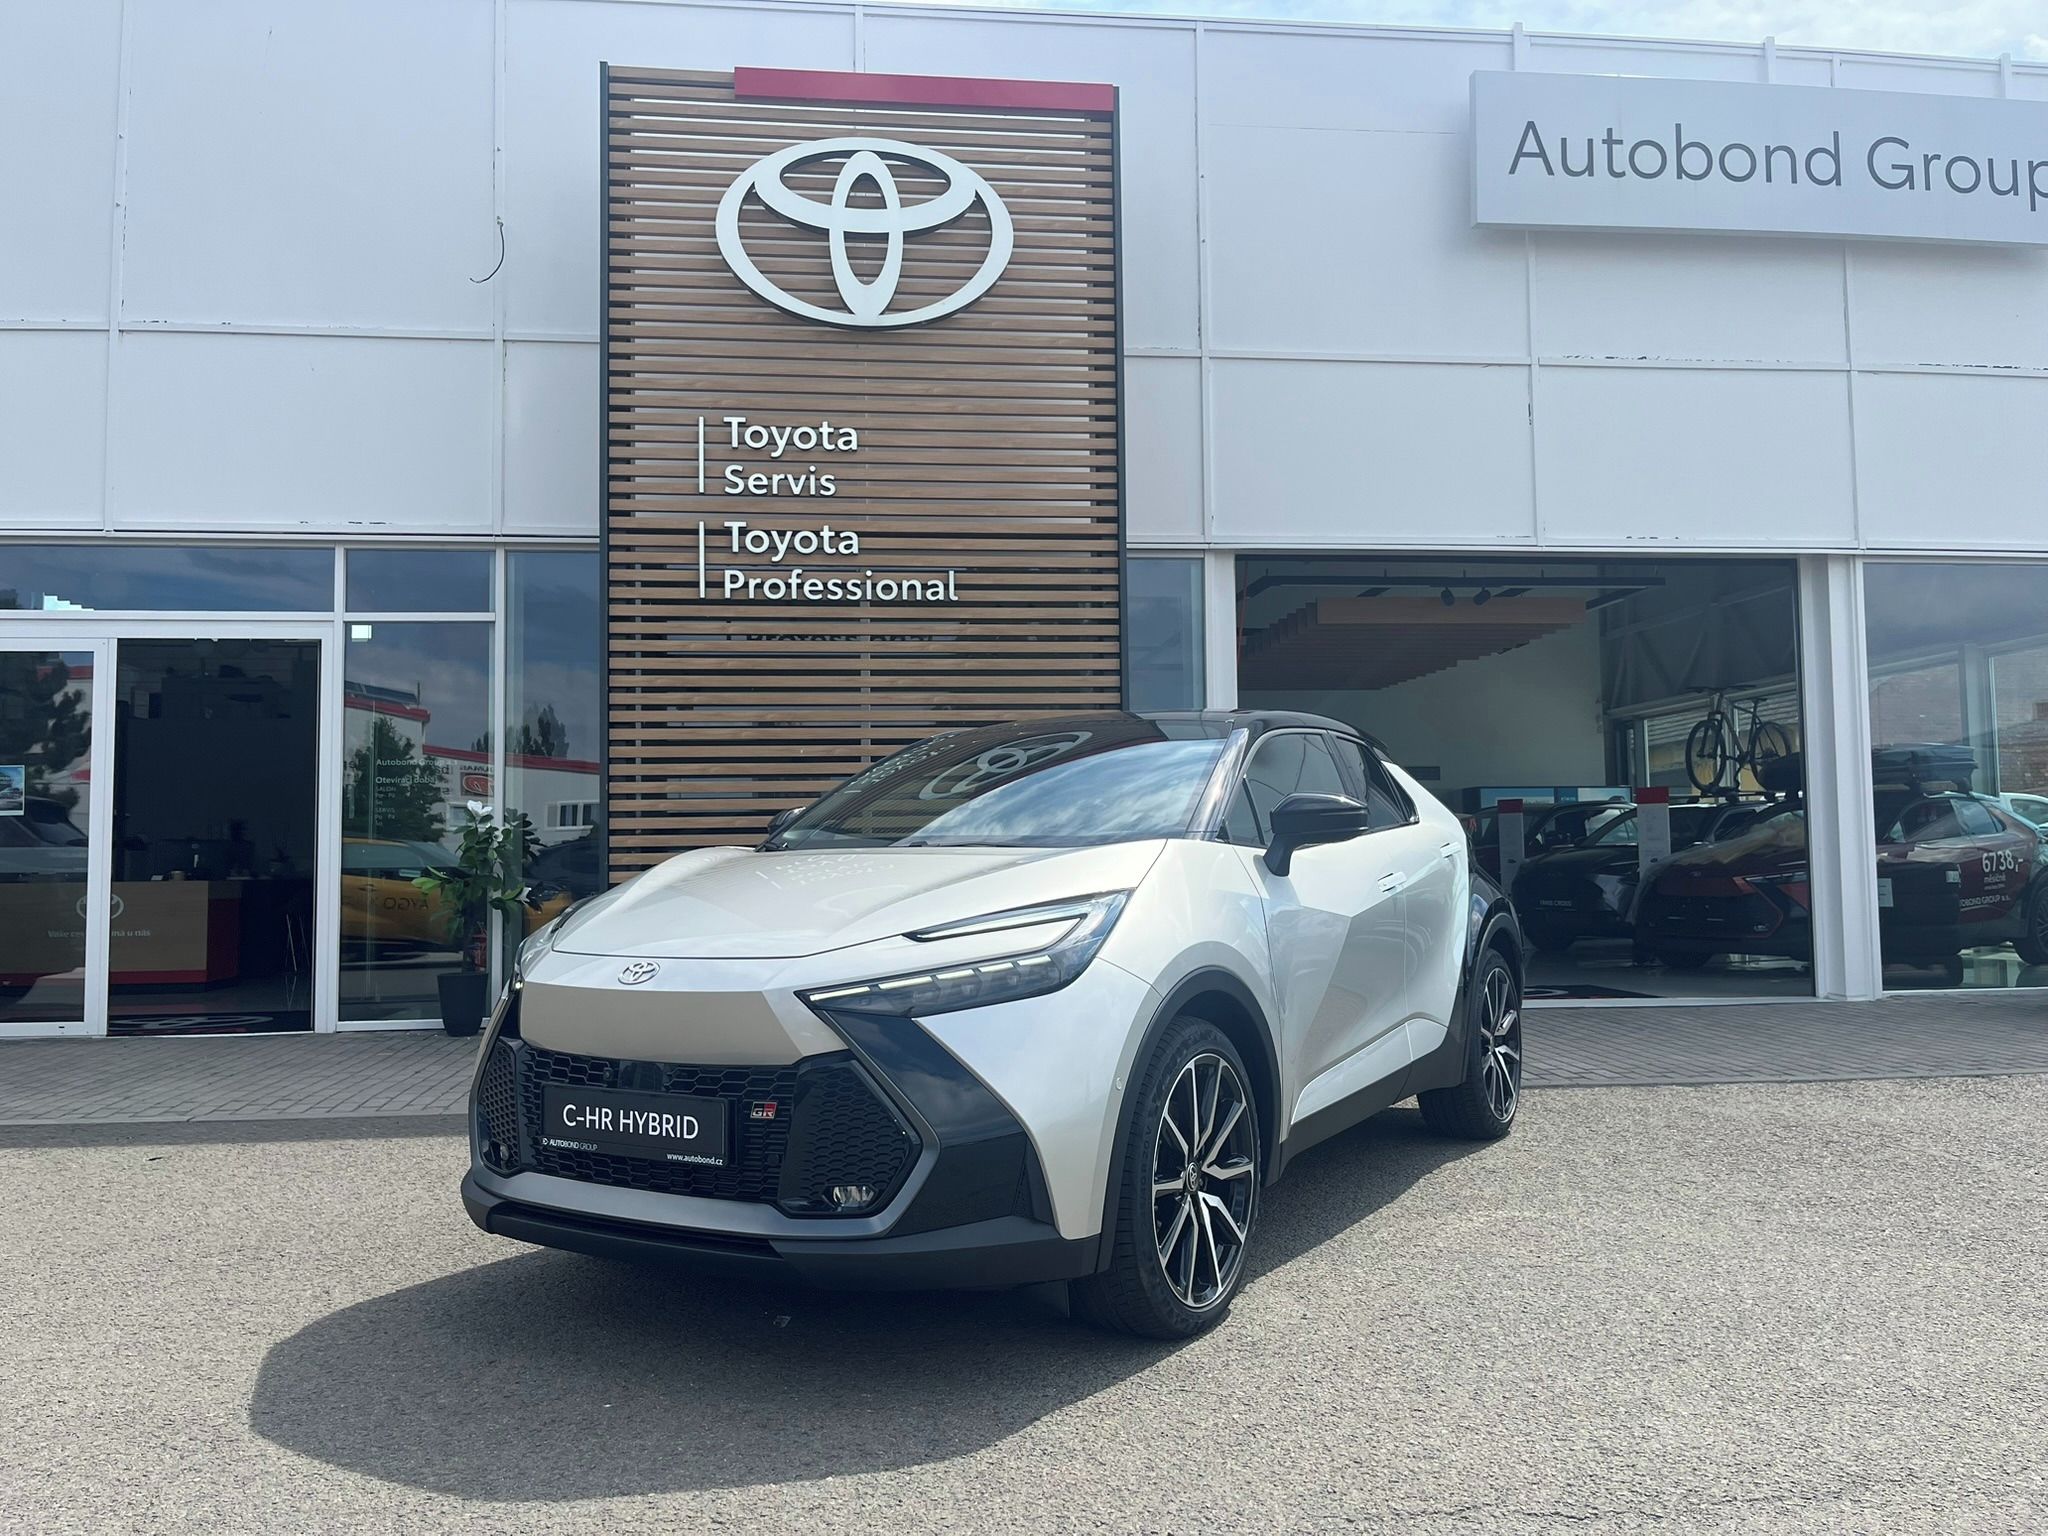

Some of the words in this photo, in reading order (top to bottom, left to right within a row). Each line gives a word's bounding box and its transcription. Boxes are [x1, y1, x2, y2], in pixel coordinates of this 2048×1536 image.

[1508, 120, 1843, 187] Autobond
[1866, 136, 2048, 212] Group
[723, 416, 859, 458] Toyota
[724, 465, 837, 496] Servis
[724, 521, 860, 563] Toyota
[724, 569, 959, 601] Professional
[376, 759, 417, 767] Autobond
[562, 1103, 613, 1132] C-HR
[619, 1110, 699, 1140] HYBRID
[549, 1138, 580, 1150] AUTOBOND
[580, 1142, 598, 1151] GROUP
[666, 1153, 723, 1166] www.autobond.cz
